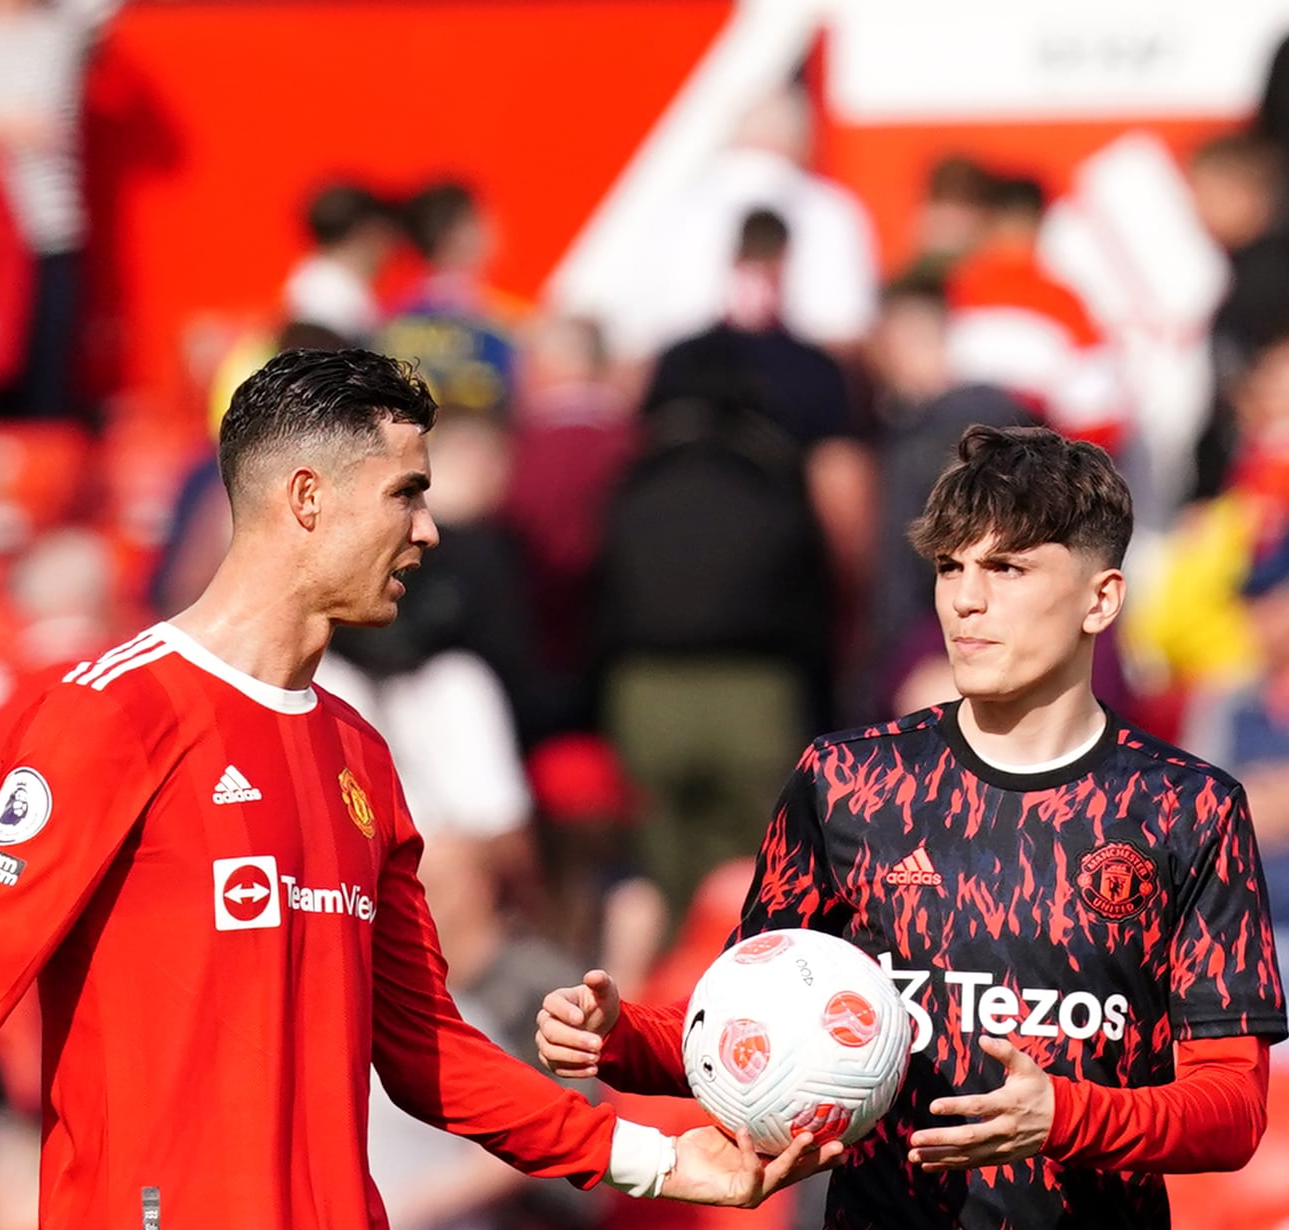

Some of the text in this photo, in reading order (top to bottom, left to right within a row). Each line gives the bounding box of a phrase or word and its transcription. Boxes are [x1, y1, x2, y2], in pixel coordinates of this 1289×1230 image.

[212, 787, 262, 804] adidas
[1086, 848, 1148, 877] MANCHESTER
[886, 870, 942, 885] adidas
[943, 971, 1129, 1042] Tezos
